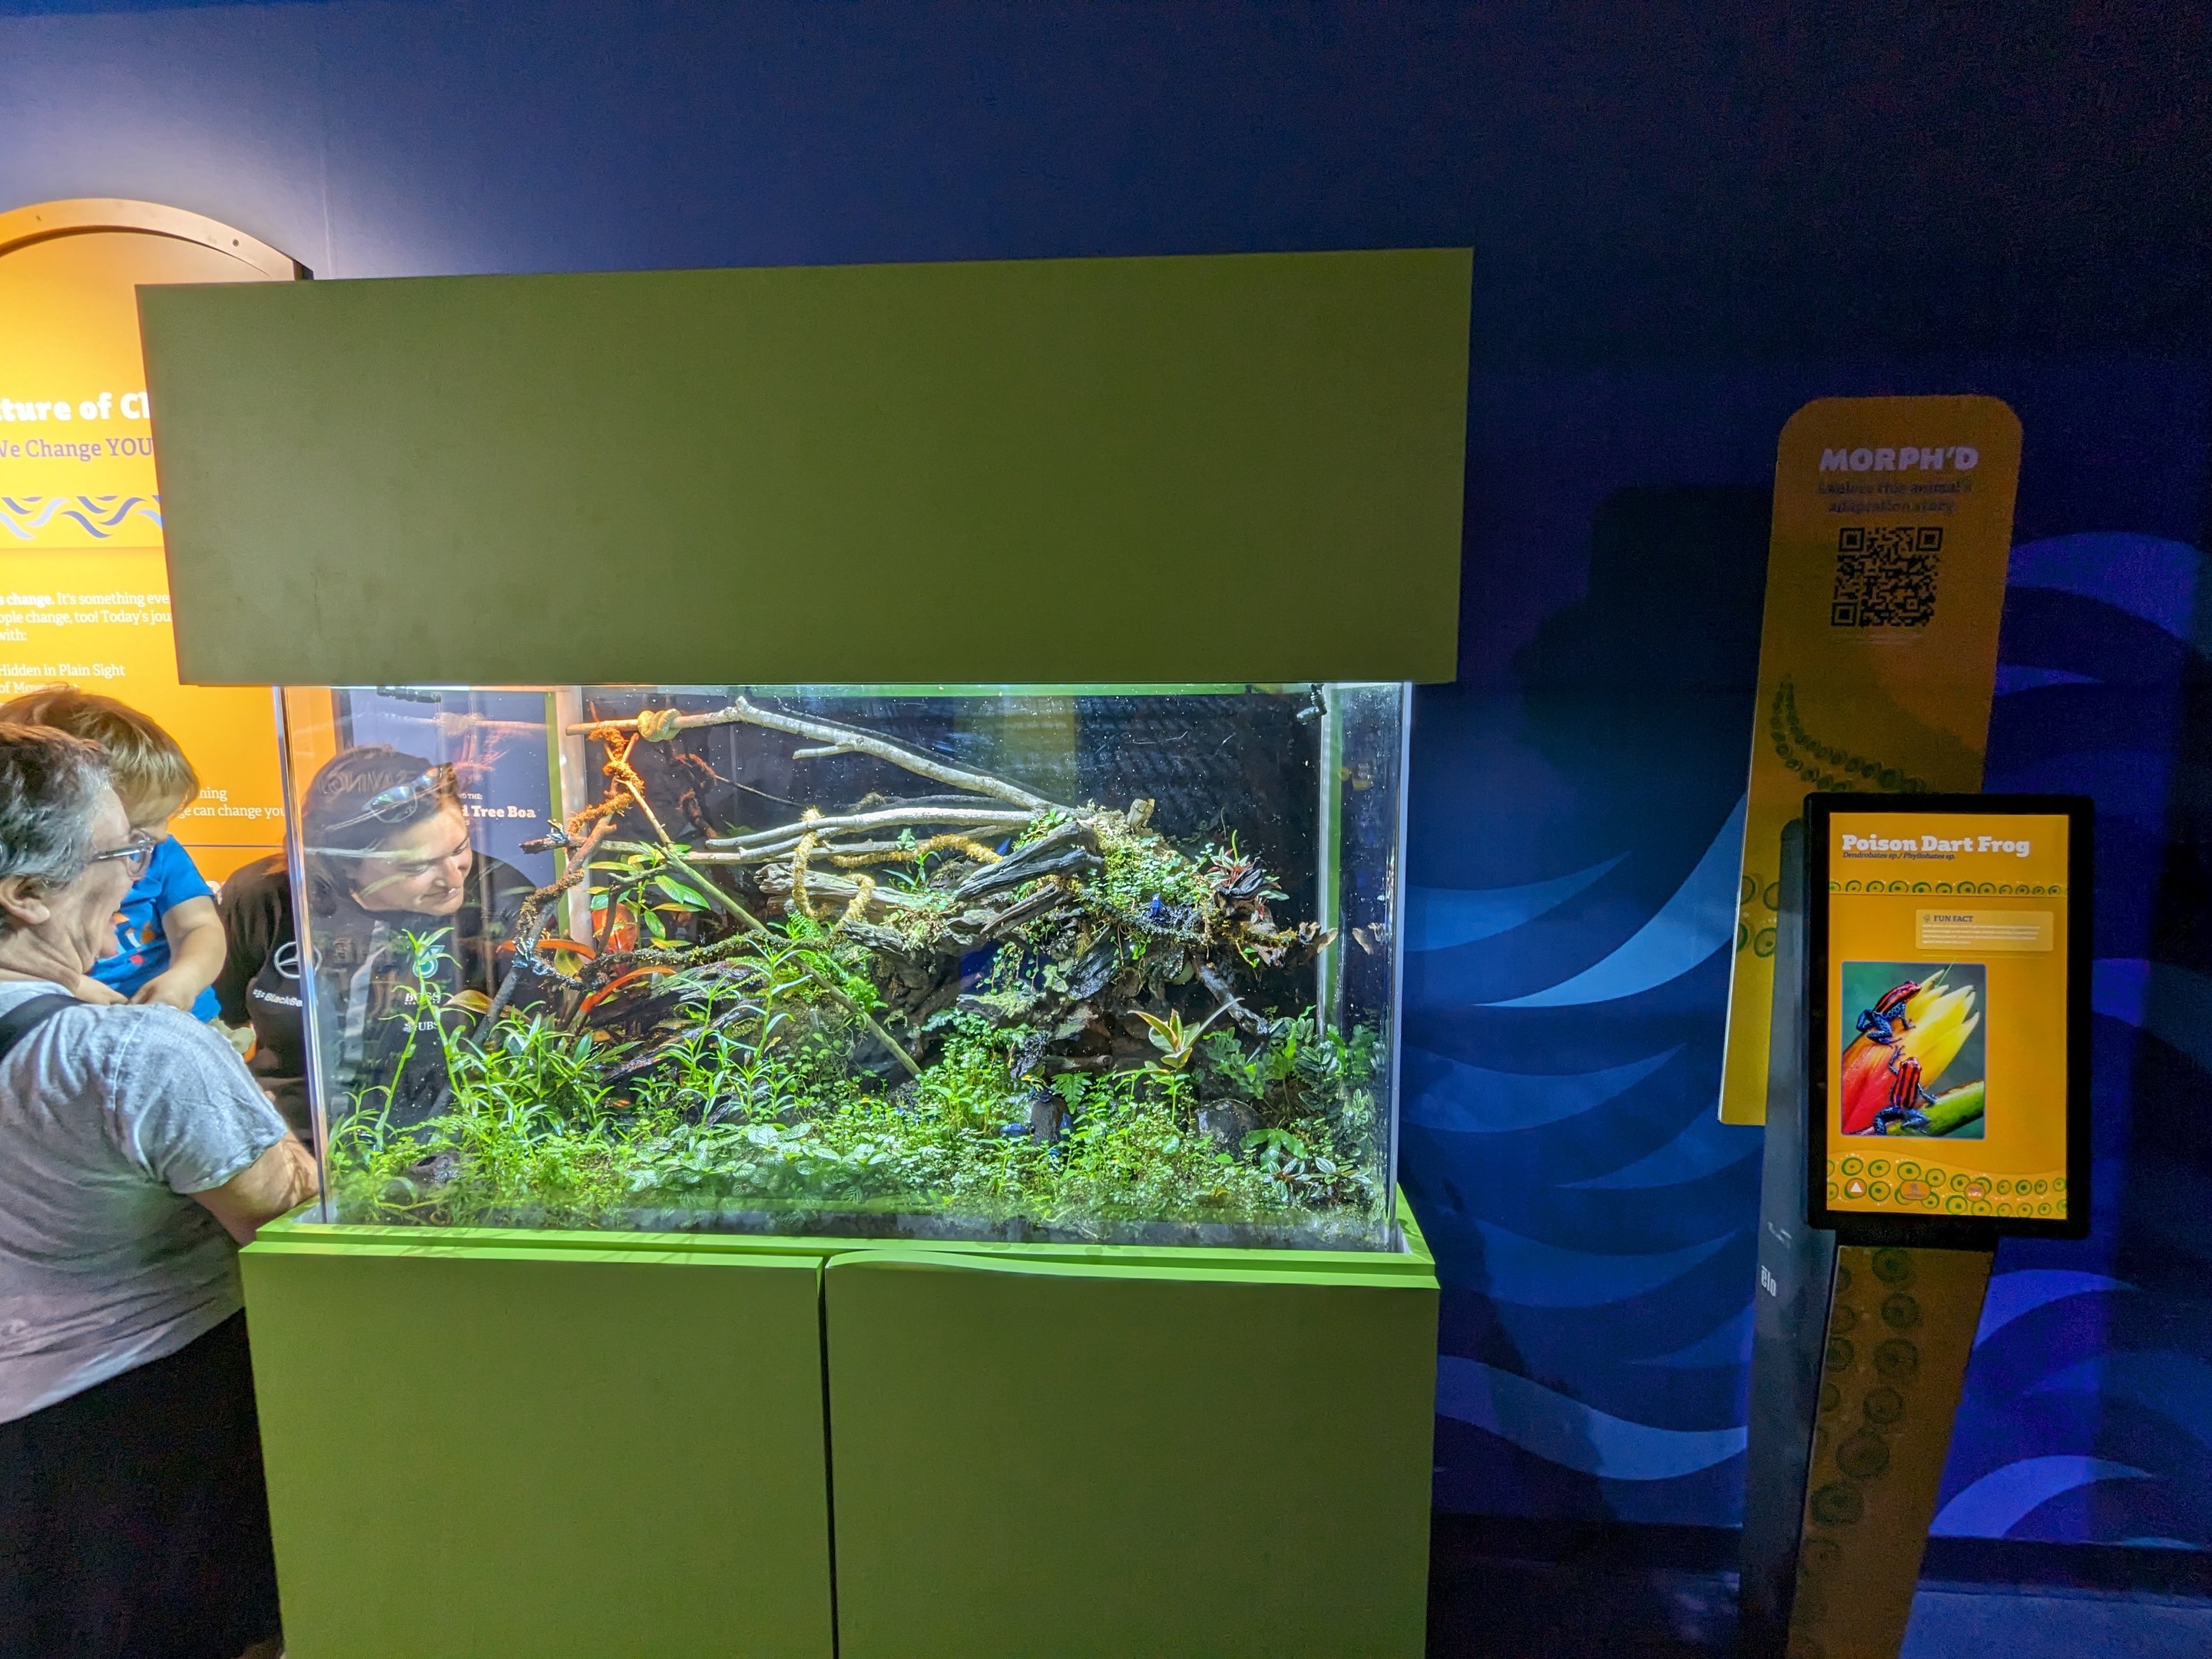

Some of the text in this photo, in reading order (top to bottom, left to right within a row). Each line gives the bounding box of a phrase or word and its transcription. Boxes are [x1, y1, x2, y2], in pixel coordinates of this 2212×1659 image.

[0, 397, 72, 422] ture
[78, 392, 113, 421] of
[25, 439, 101, 462] Change
[1818, 445, 1980, 472] MORPH'D
[6, 591, 55, 608] change.
[57, 591, 77, 604] It's
[78, 591, 145, 608] something
[147, 594, 171, 604] eve
[25, 610, 73, 626] change,
[75, 611, 98, 623] too!
[100, 609, 149, 625] Today's
[44, 664, 56, 676] in
[58, 663, 91, 677] Plain
[93, 664, 126, 679] Sight
[193, 806, 216, 816] can
[217, 803, 262, 820] change
[471, 805, 505, 818] Tree
[507, 806, 536, 819] Boa
[1842, 833, 2030, 857] Poison Dart Frog
[264, 992, 303, 1007] BlackBe
